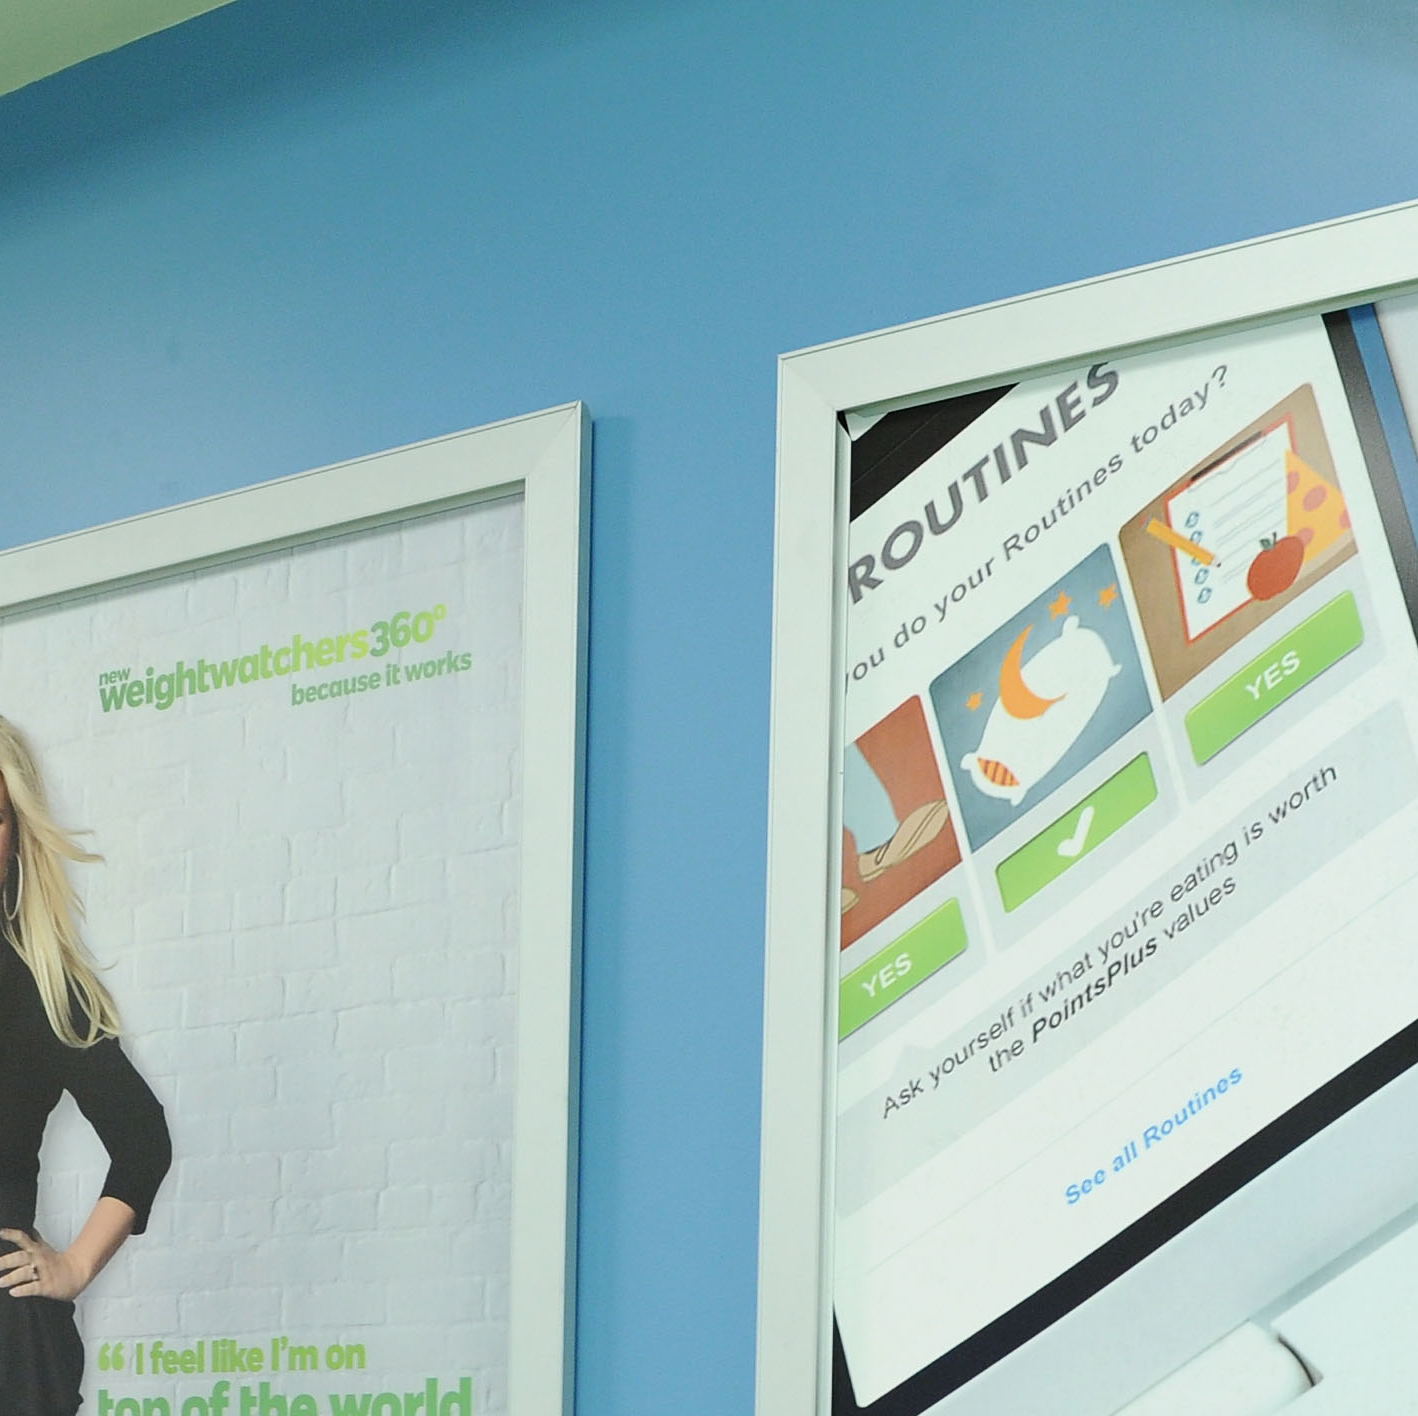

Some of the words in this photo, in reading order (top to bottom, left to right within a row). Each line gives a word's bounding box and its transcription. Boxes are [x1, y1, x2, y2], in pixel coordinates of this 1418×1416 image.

[846, 362, 1121, 604] ROUTINES
[894, 615, 928, 650] do
[933, 559, 994, 622] your
[1002, 453, 1125, 562] Routines
[1130, 364, 1231, 454] today?
[99, 667, 130, 685] new
[291, 669, 381, 706] because
[385, 664, 400, 688] it
[404, 650, 472, 684] works
[1244, 650, 1300, 703] YES
[860, 952, 914, 1000] YES
[883, 1077, 925, 1121] Ask
[929, 1005, 1017, 1092] yourself
[1020, 996, 1035, 1020] if
[1038, 952, 1093, 1004] what
[1099, 897, 1166, 969] you're
[1170, 839, 1240, 904] eating
[1242, 821, 1264, 847] is
[1267, 763, 1339, 823] worth
[988, 1038, 1026, 1075] the
[1031, 938, 1161, 1046] PointsPlus
[1161, 876, 1238, 941] values
[1065, 1166, 1108, 1206] See
[1111, 1141, 1138, 1173] all
[1141, 1066, 1244, 1149] Routines
[150, 1340, 206, 1375] feel
[211, 1338, 265, 1373] like
[325, 1342, 367, 1371] on
